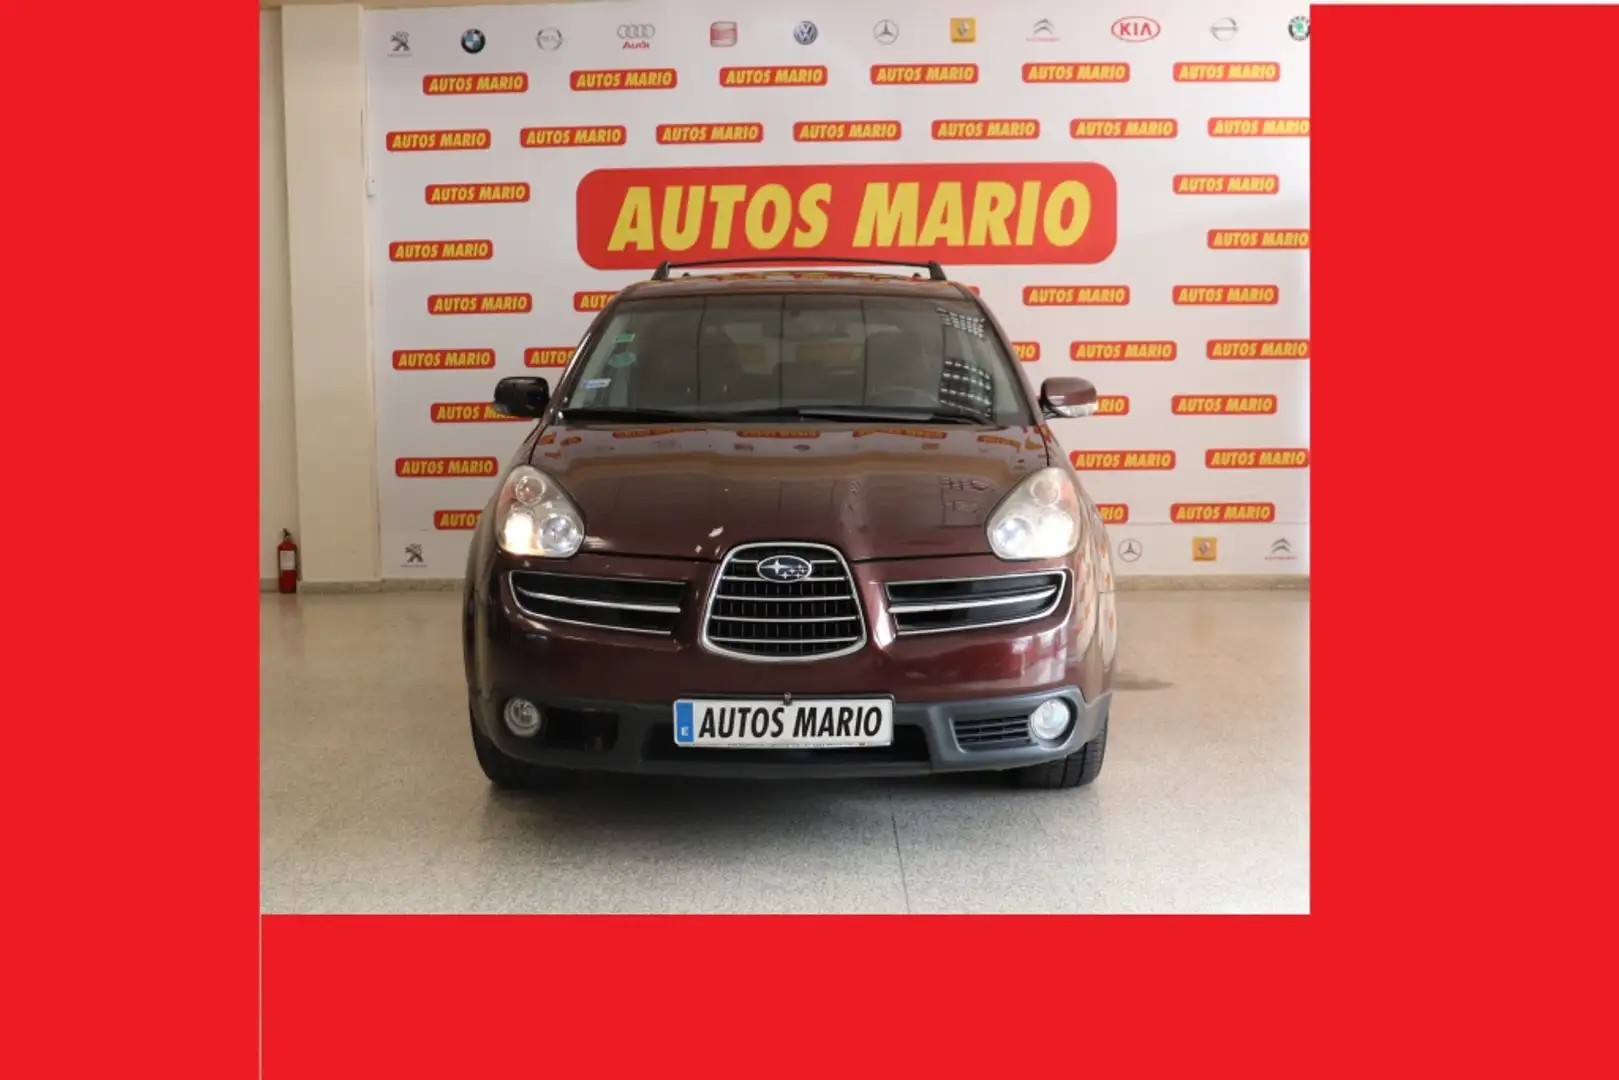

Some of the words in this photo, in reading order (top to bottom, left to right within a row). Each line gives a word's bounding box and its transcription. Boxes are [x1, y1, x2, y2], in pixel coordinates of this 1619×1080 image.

[1118, 22, 1153, 36] KIA
[576, 73, 621, 88] AUTOS
[624, 71, 672, 87] MARIO
[726, 69, 772, 84] AUTOS
[775, 68, 823, 84] MARIO
[878, 67, 924, 82] AUTOS
[927, 66, 975, 81] MARIO
[1028, 66, 1074, 80] AUTOS
[1077, 65, 1125, 80] MARIO
[1179, 65, 1225, 79] AUTOS
[1228, 65, 1276, 79] MARIO
[430, 77, 474, 92] AUTOS
[477, 75, 523, 91] MARIO
[663, 126, 708, 142] AUTOS
[711, 125, 758, 141] MARIO
[800, 124, 845, 139] AUTOS
[848, 123, 896, 138] MARIO
[939, 122, 984, 137] AUTOS
[987, 122, 1035, 137] MARIO
[1076, 121, 1122, 136] AUTOS
[1125, 121, 1173, 136] MARIO
[1214, 120, 1259, 134] AUTOS
[1262, 120, 1309, 134] MARIO
[392, 133, 437, 149] AUTOS
[440, 132, 487, 147] MARIO
[526, 129, 571, 145] AUTOS
[574, 129, 622, 144] MARIO
[1179, 177, 1224, 192] AUTOS
[1227, 177, 1275, 191] MARIO
[431, 186, 476, 202] AUTOS
[479, 185, 526, 201] MARIO
[607, 183, 832, 251] AUTOS
[852, 180, 1092, 248] MARIO
[1213, 232, 1258, 247] AUTOS
[1261, 231, 1309, 247] MARIO
[394, 243, 438, 259] AUTOS
[441, 242, 488, 258] MARIO
[1029, 288, 1074, 303] AUTOS
[1077, 288, 1125, 303] MARIO
[1178, 287, 1223, 303] AUTOS
[1226, 287, 1274, 303] MARIO
[434, 296, 478, 312] AUTOS
[481, 296, 528, 311] MARIO
[1075, 344, 1121, 359] AUTOS
[1124, 343, 1172, 359] MARIO
[1212, 342, 1257, 357] AUTOS
[1260, 341, 1308, 357] MARIO
[399, 352, 442, 368] AUTOS
[445, 351, 491, 367] MARIO
[436, 405, 480, 420] AUTOS
[1177, 397, 1222, 413] AUTOS
[1225, 397, 1273, 412] MARIO
[1075, 453, 1120, 468] AUTOS
[1123, 453, 1171, 468] MARIO
[1211, 451, 1256, 466] AUTOS
[1259, 451, 1306, 466] MARIO
[402, 460, 446, 476] AUTOS
[449, 459, 495, 475] MARIO
[1176, 505, 1221, 521] AUTOS
[1224, 505, 1272, 521] MARIO
[699, 707, 785, 738] AUTOS
[793, 706, 883, 738] MARIO
